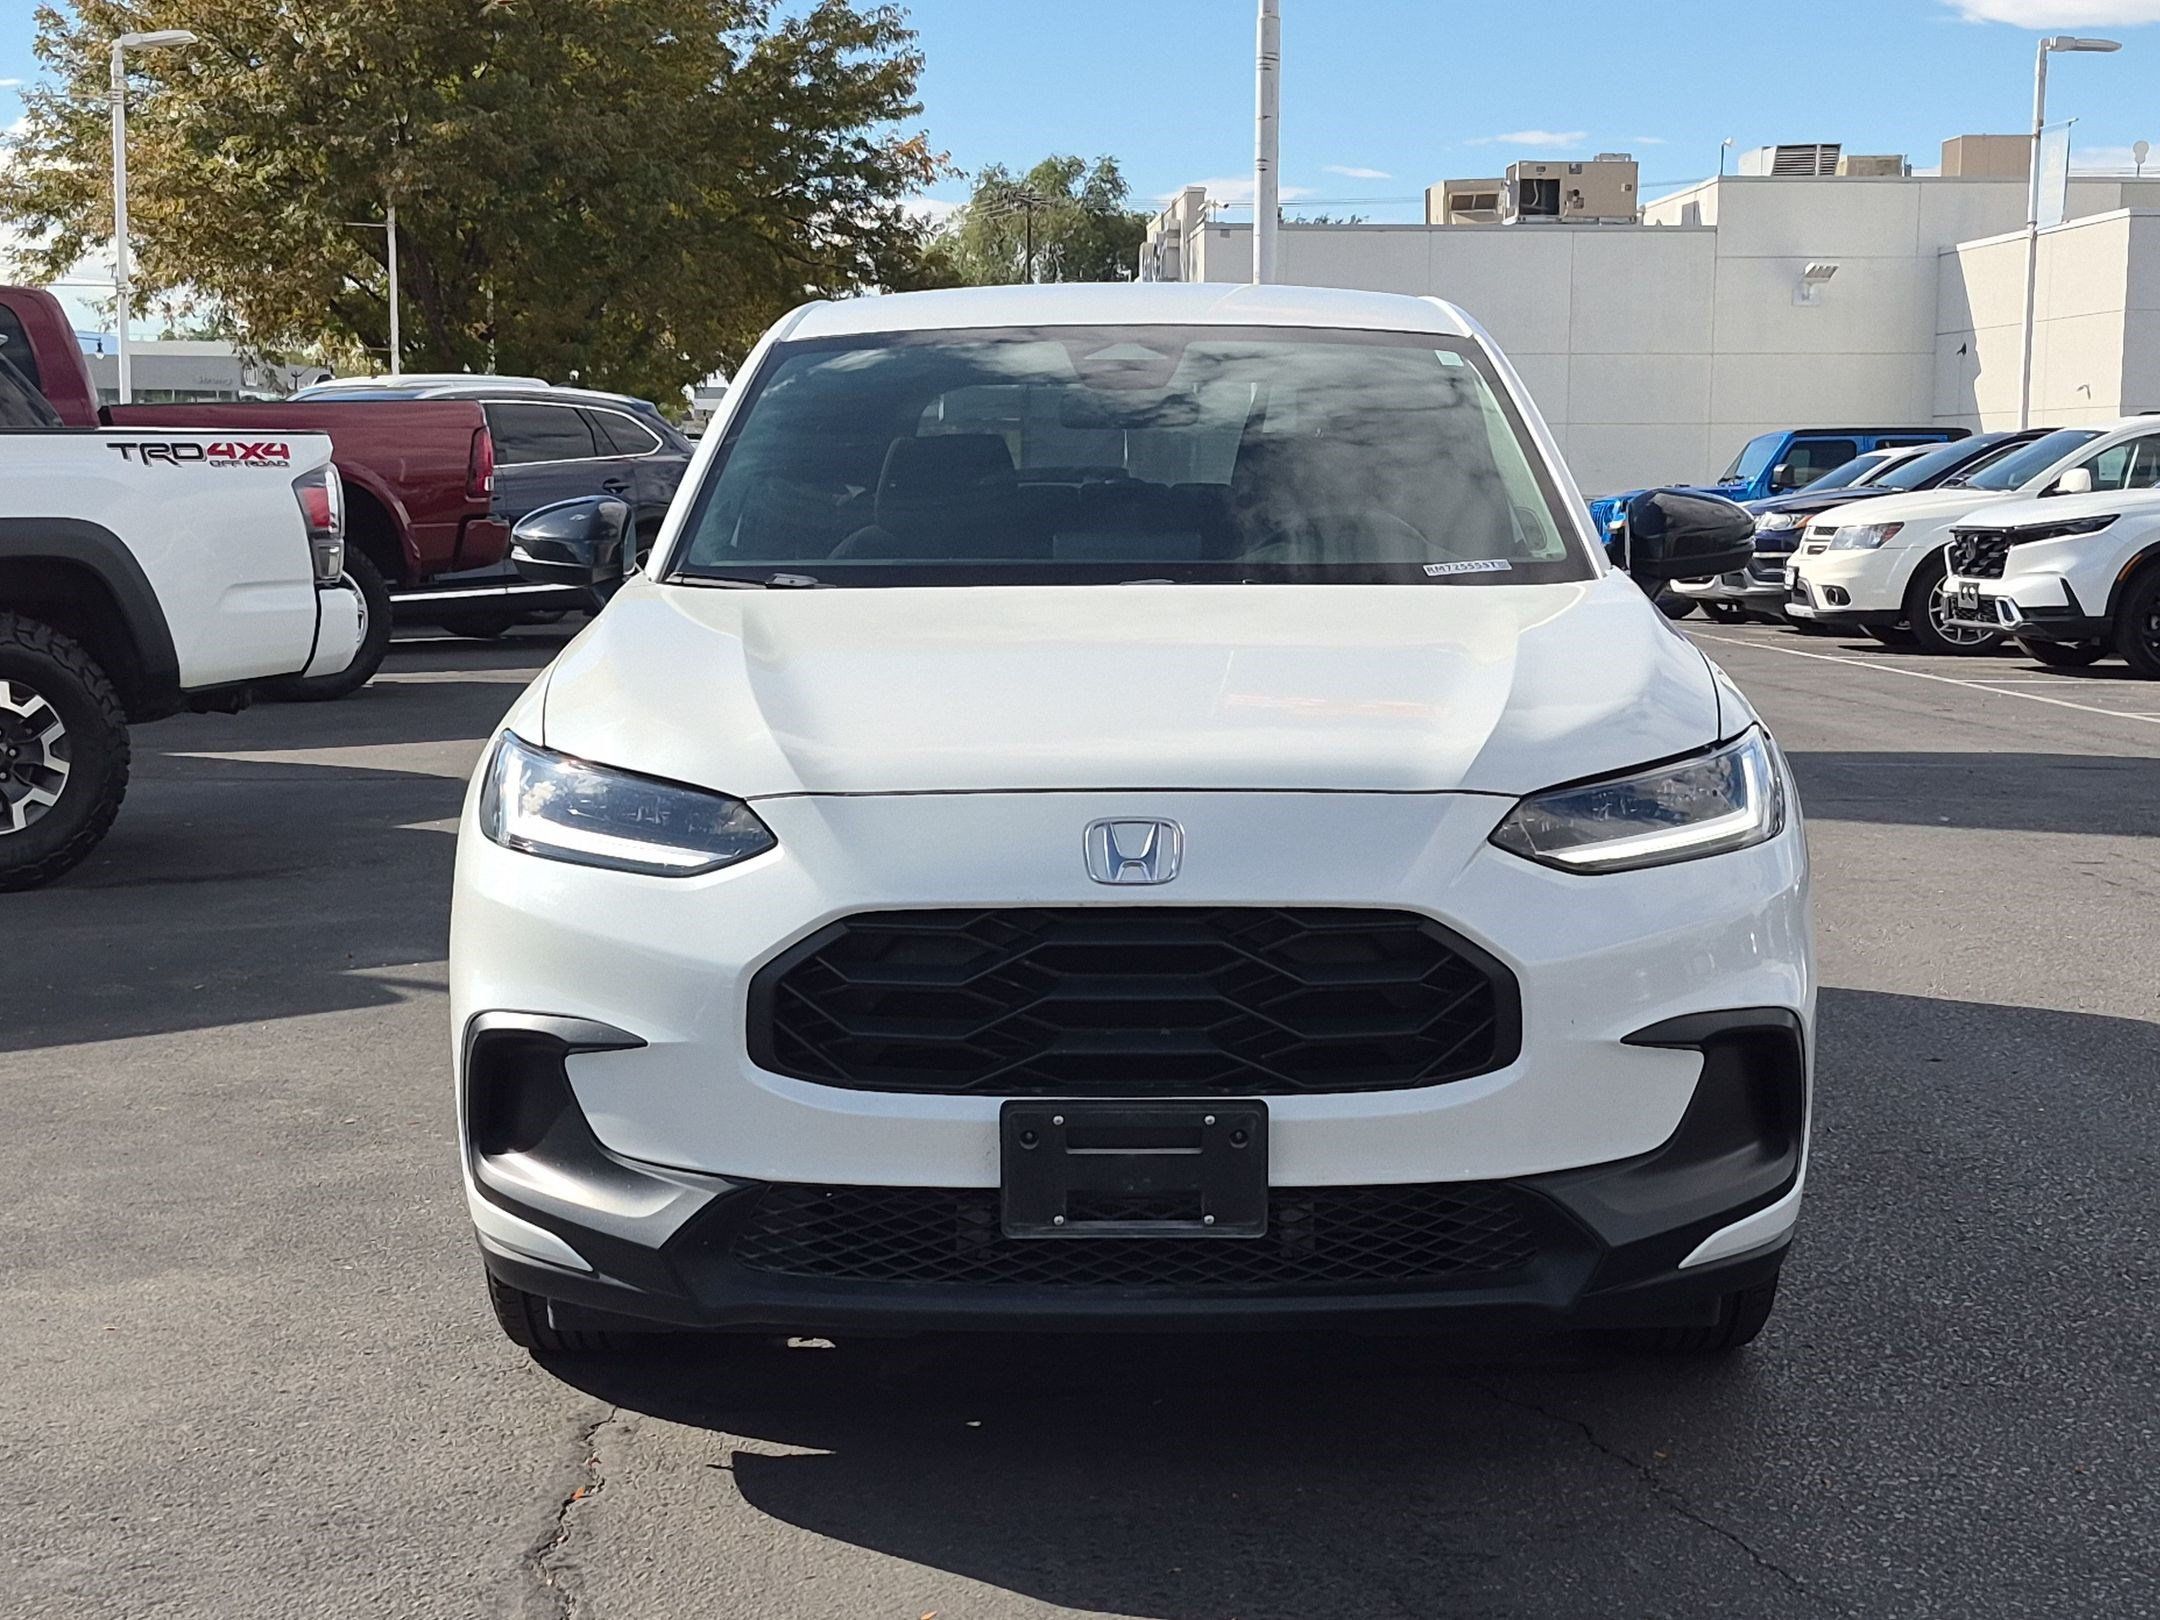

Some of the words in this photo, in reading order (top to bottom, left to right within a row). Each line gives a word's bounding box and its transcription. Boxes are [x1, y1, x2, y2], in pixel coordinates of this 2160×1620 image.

[106, 442, 207, 467] TRD
[209, 460, 243, 468] OFF
[244, 460, 291, 468] ROAD
